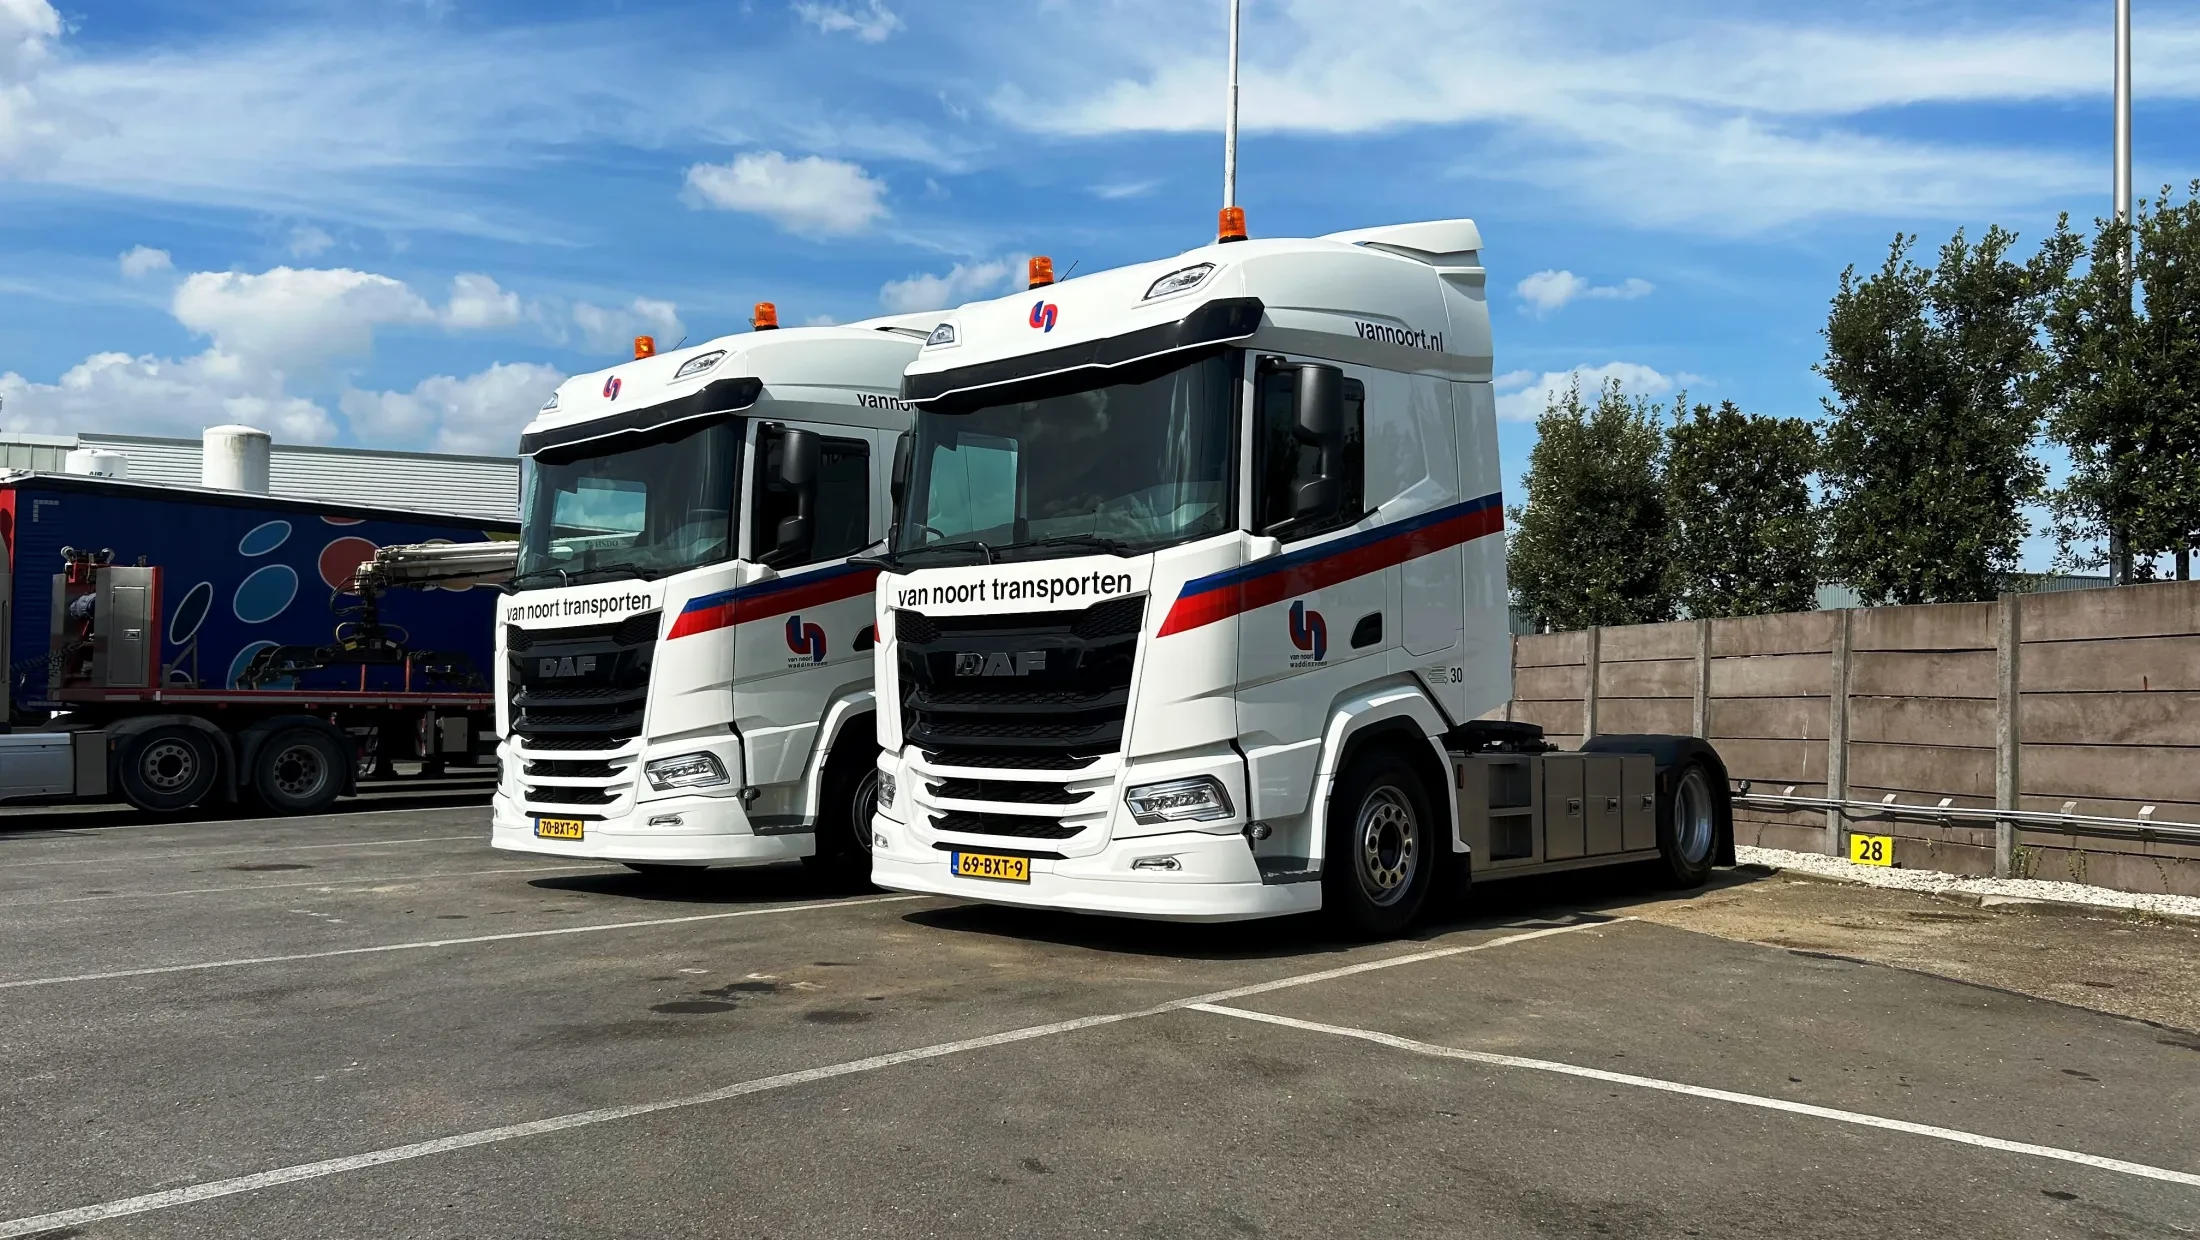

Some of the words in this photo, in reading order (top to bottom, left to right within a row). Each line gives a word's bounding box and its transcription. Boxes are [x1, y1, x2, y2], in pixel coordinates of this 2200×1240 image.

[1354, 321, 1444, 352] vannoort.nl
[898, 587, 928, 607] van
[932, 578, 986, 604] noort
[991, 571, 1132, 603] transporten
[506, 606, 525, 622] van
[527, 599, 560, 619] noort
[563, 592, 652, 619] transporten
[538, 655, 597, 678] DAF
[955, 650, 1047, 677] DAF
[1450, 667, 1463, 683] 30
[541, 820, 579, 836] 70-BXT-9
[1859, 839, 1883, 861] 28
[962, 856, 1023, 877] 69-BXT-9
